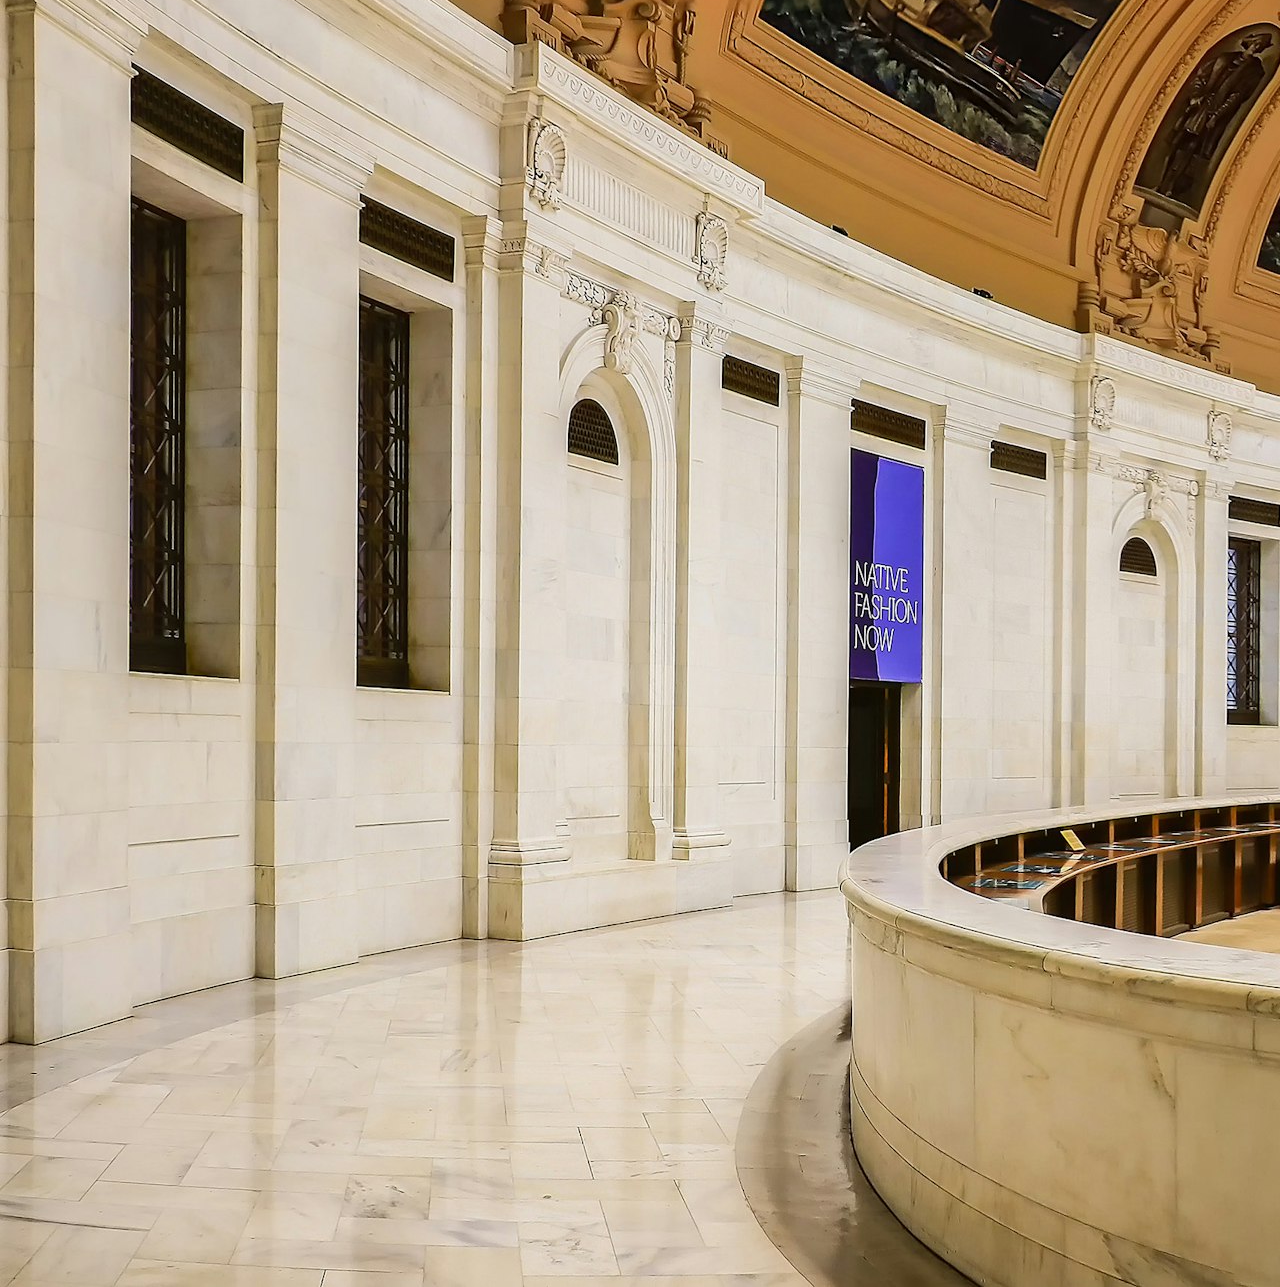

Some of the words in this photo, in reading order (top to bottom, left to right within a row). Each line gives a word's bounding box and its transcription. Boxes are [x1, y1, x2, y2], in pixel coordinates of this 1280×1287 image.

[854, 560, 909, 593] NATIVE
[854, 591, 918, 624] FASHION
[854, 623, 895, 652] NOW
